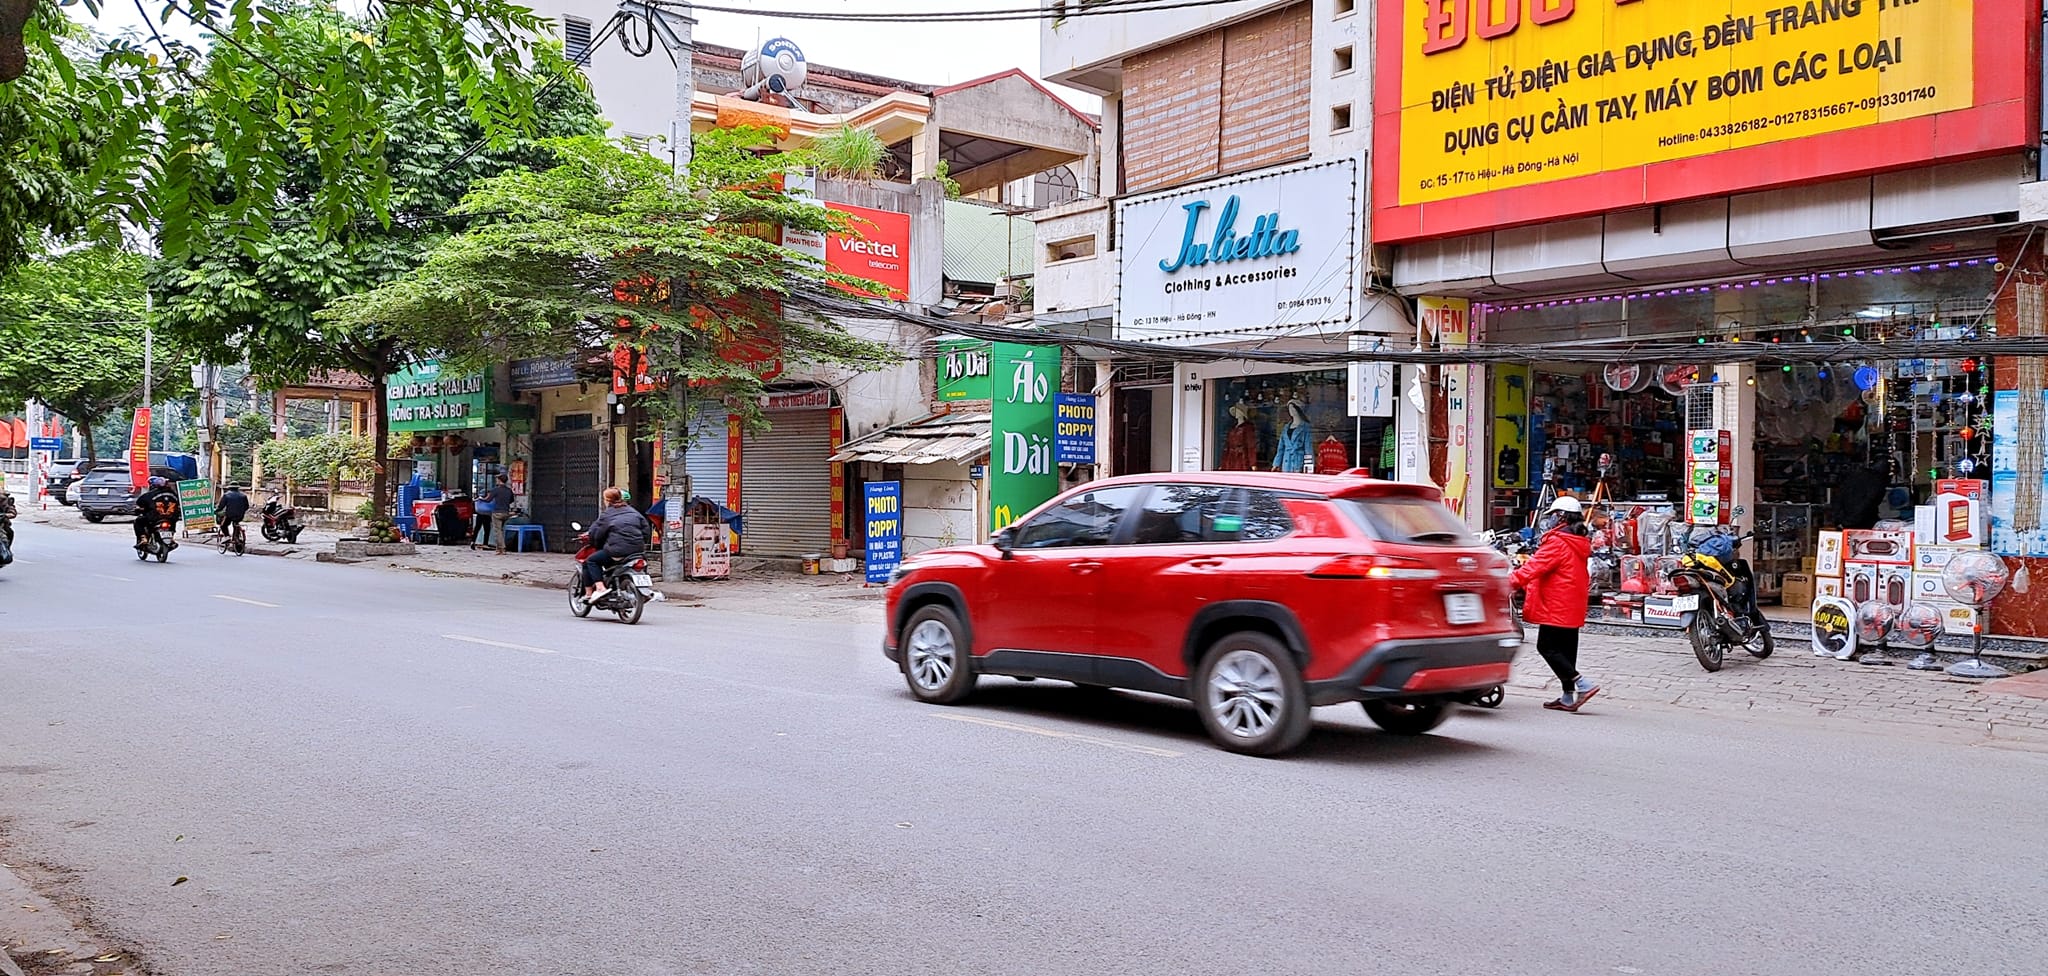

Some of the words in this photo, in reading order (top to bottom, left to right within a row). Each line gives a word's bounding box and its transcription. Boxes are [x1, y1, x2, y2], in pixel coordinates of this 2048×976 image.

[1431, 81, 1475, 114] ĐIỆN
[1484, 65, 1516, 101] TỬ,
[1520, 59, 1569, 94] ĐIỆN
[1577, 51, 1616, 79] GIA
[1625, 30, 1697, 70] DỤNG,
[1703, 15, 1754, 52] ĐÈN
[1766, 0, 1861, 36] TRANG
[1444, 122, 1499, 155] DỤNG
[1507, 114, 1535, 143] CỤ
[1540, 98, 1589, 135] CẦM
[1596, 93, 1638, 125] TAY,
[1645, 78, 1698, 115] MÁY
[1708, 65, 1763, 101] BƠM
[1773, 51, 1827, 88] CÁC
[1838, 37, 1901, 77] LOẠI
[1658, 132, 1698, 148] Hotline:
[1563, 152, 1580, 166] Nội
[1159, 194, 1302, 273] Julietta
[839, 238, 900, 259] viettel
[868, 259, 900, 270] telecom
[1164, 277, 1211, 295] Clothing
[1224, 266, 1297, 288] Accessories
[944, 346, 965, 381] Áo
[964, 351, 989, 378] Dài
[1007, 350, 1049, 405] Áo
[1058, 404, 1094, 419] PHOTO
[1058, 422, 1094, 437] COPPY
[1002, 430, 1050, 476] Dài
[868, 496, 897, 514] PHOTO
[868, 519, 898, 538] COPPY
